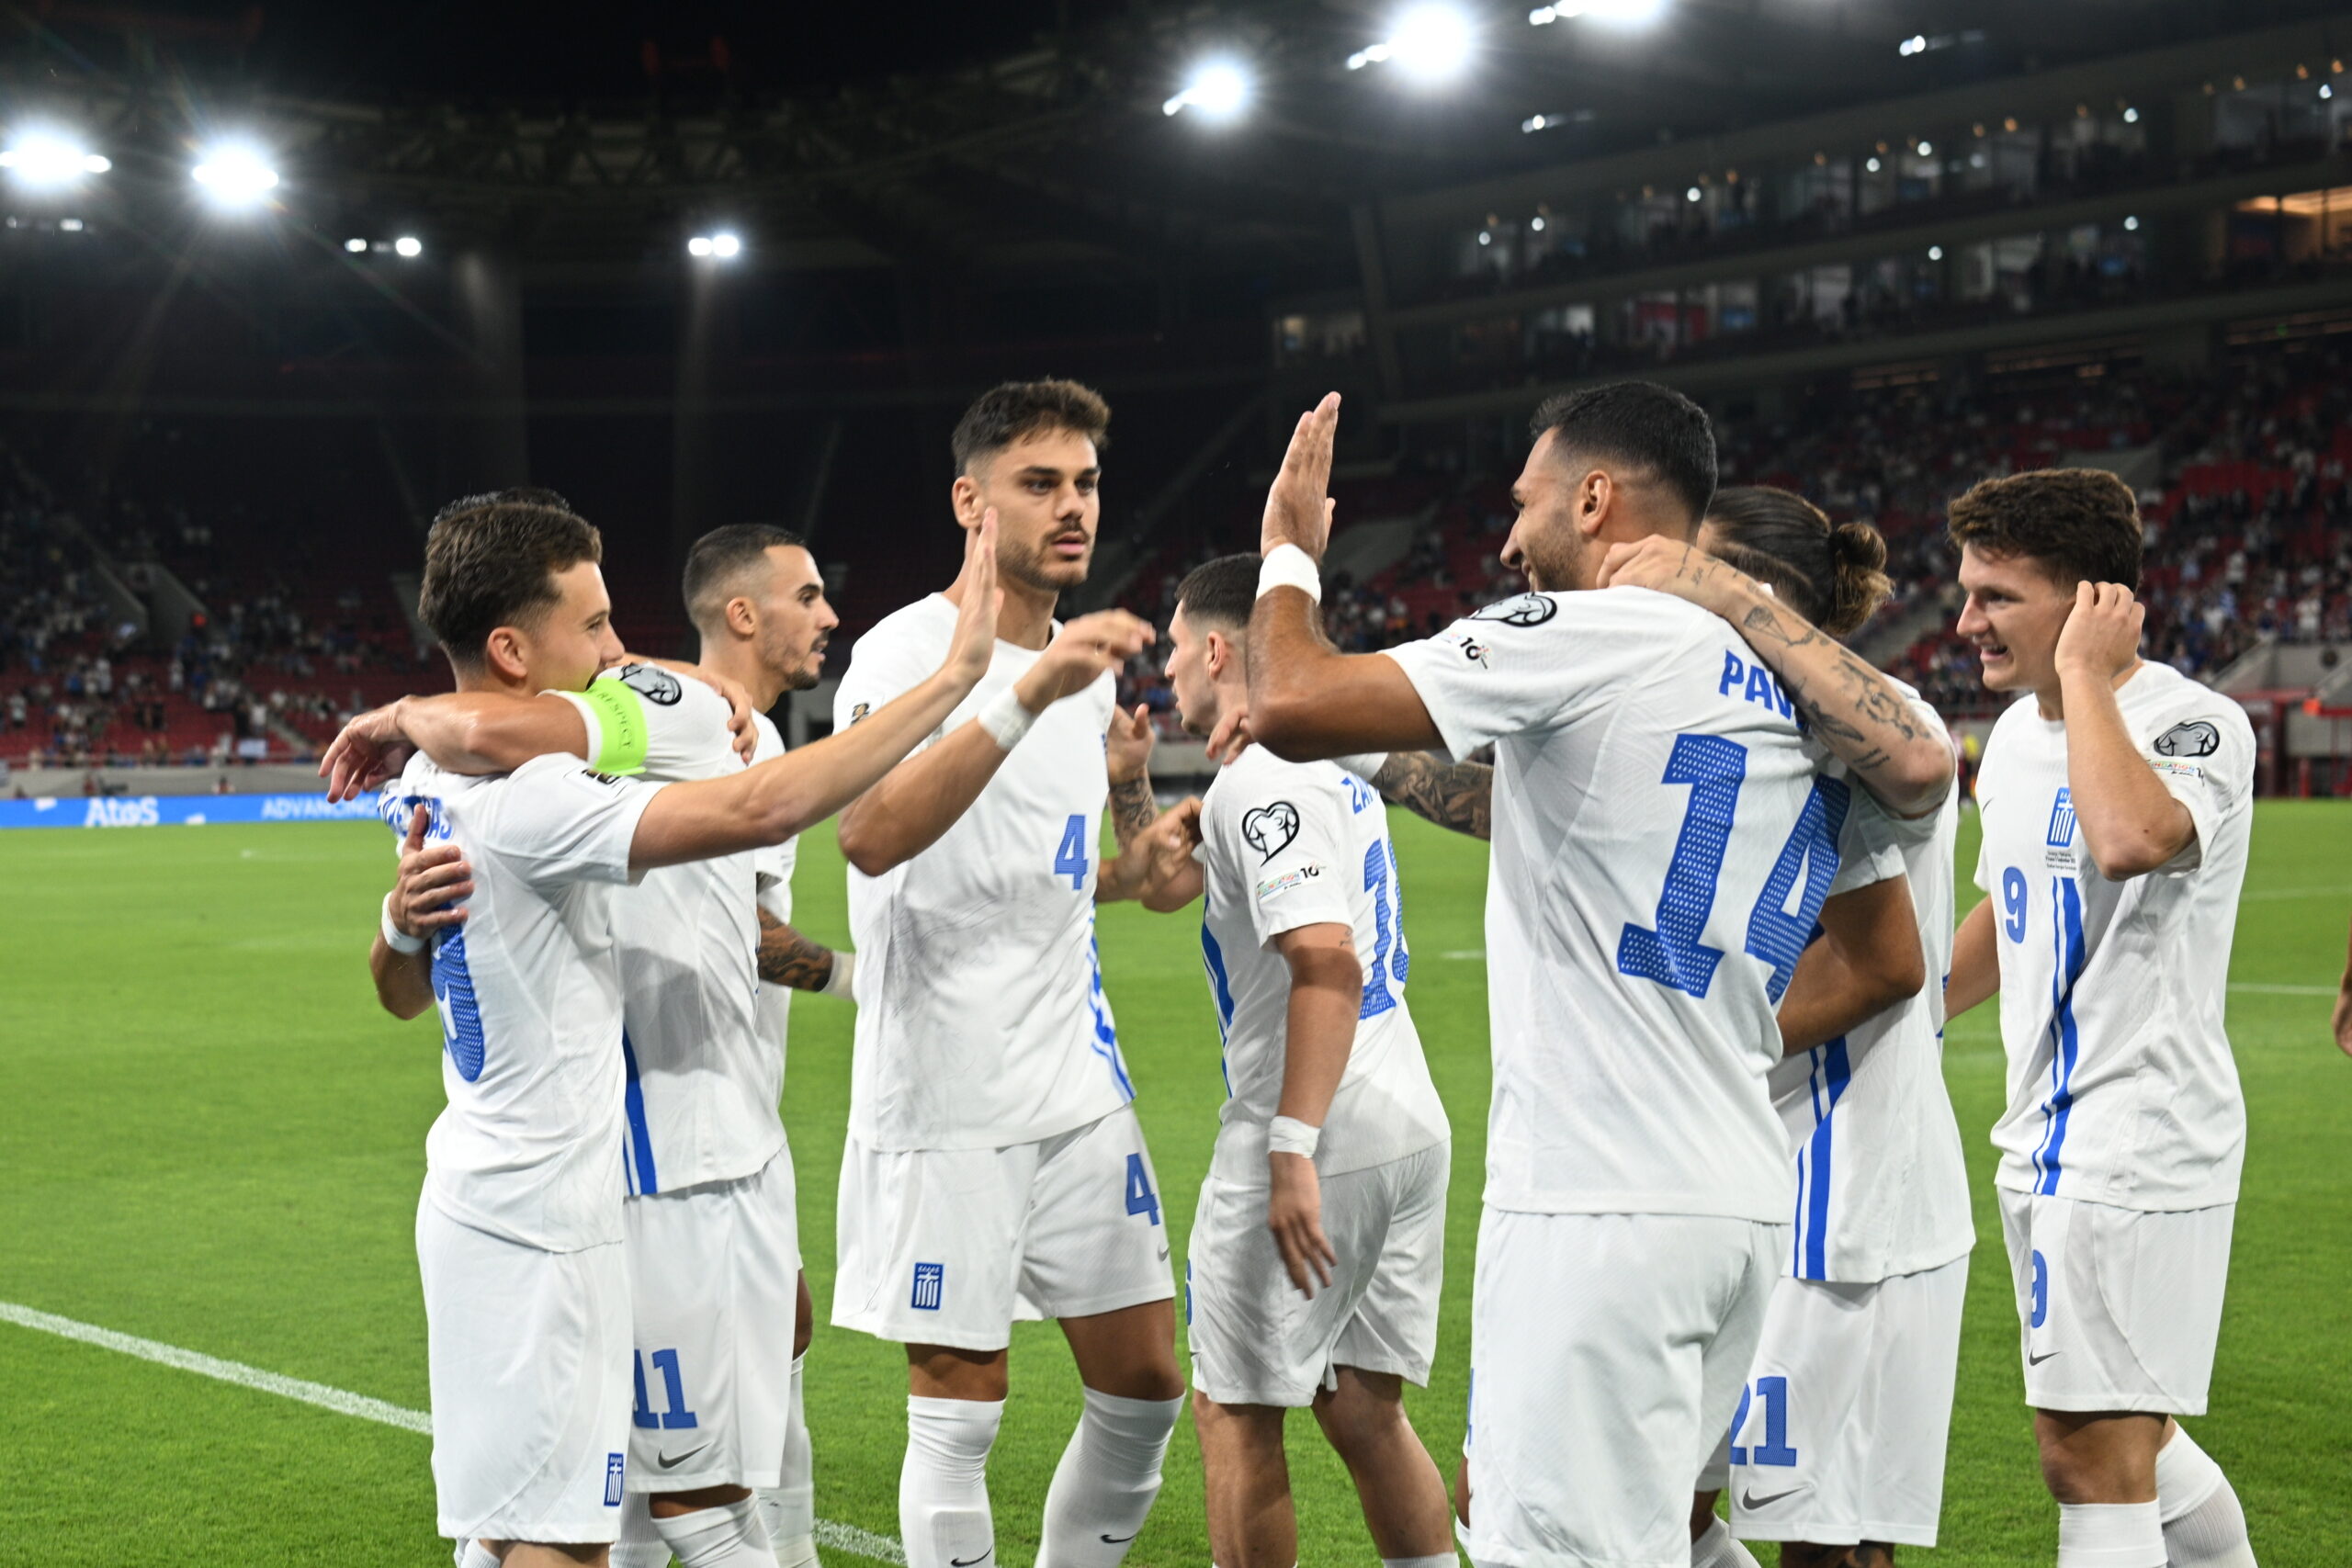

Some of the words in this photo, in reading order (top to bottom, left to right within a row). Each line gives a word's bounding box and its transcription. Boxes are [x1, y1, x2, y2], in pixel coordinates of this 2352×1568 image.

[1719, 649, 1805, 731] PAV
[1054, 814, 1088, 891] 4
[1617, 733, 1850, 1008] 14
[2003, 866, 2028, 944] 9
[1125, 1153, 1160, 1226] 4
[634, 1348, 698, 1429] 11
[1728, 1376, 1797, 1467] 21
